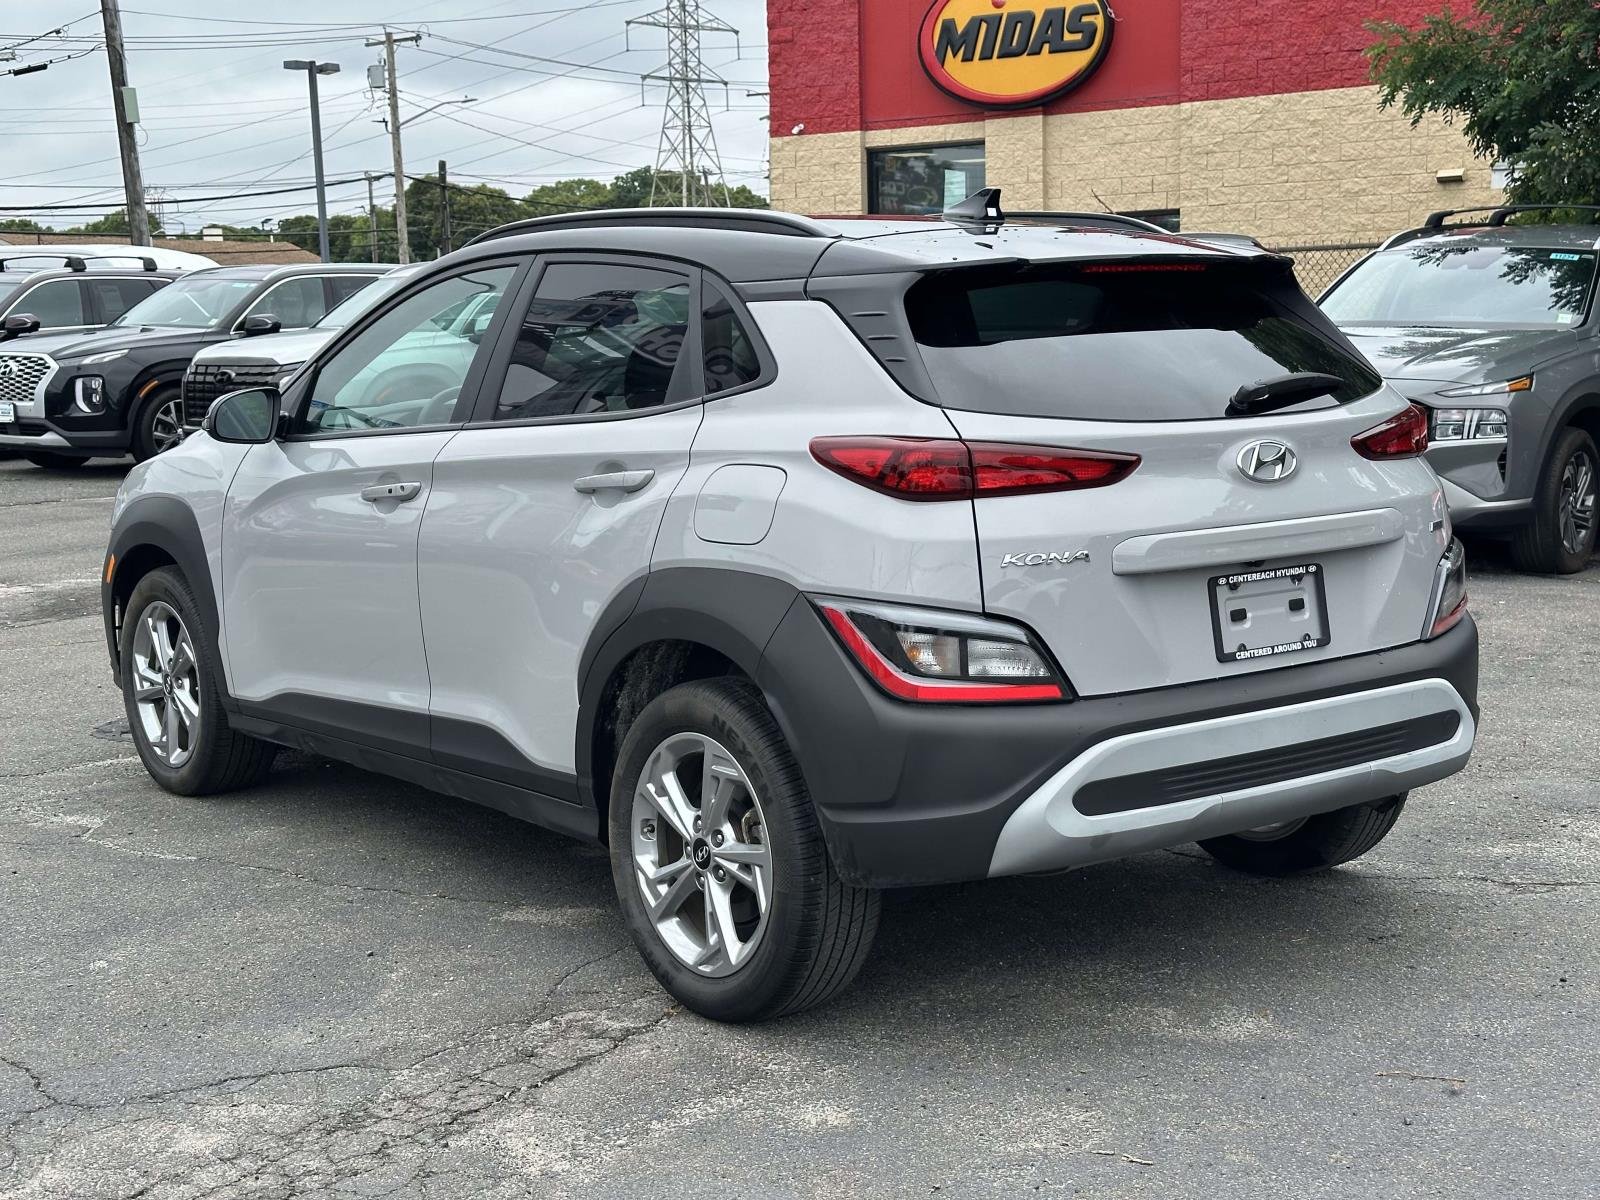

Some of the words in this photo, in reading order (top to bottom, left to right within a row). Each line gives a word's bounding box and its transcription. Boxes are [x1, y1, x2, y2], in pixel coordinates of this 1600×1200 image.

[935, 3, 1100, 67] MIDAS
[1000, 548, 1091, 569] KONA
[1228, 570, 1275, 584] CENTEREACH
[1276, 566, 1306, 577] HYUNDAI
[1235, 647, 1273, 660] CENTERED
[1273, 642, 1302, 654] AROUND
[1302, 639, 1317, 649] YOU
[712, 713, 774, 807] NEXEN
